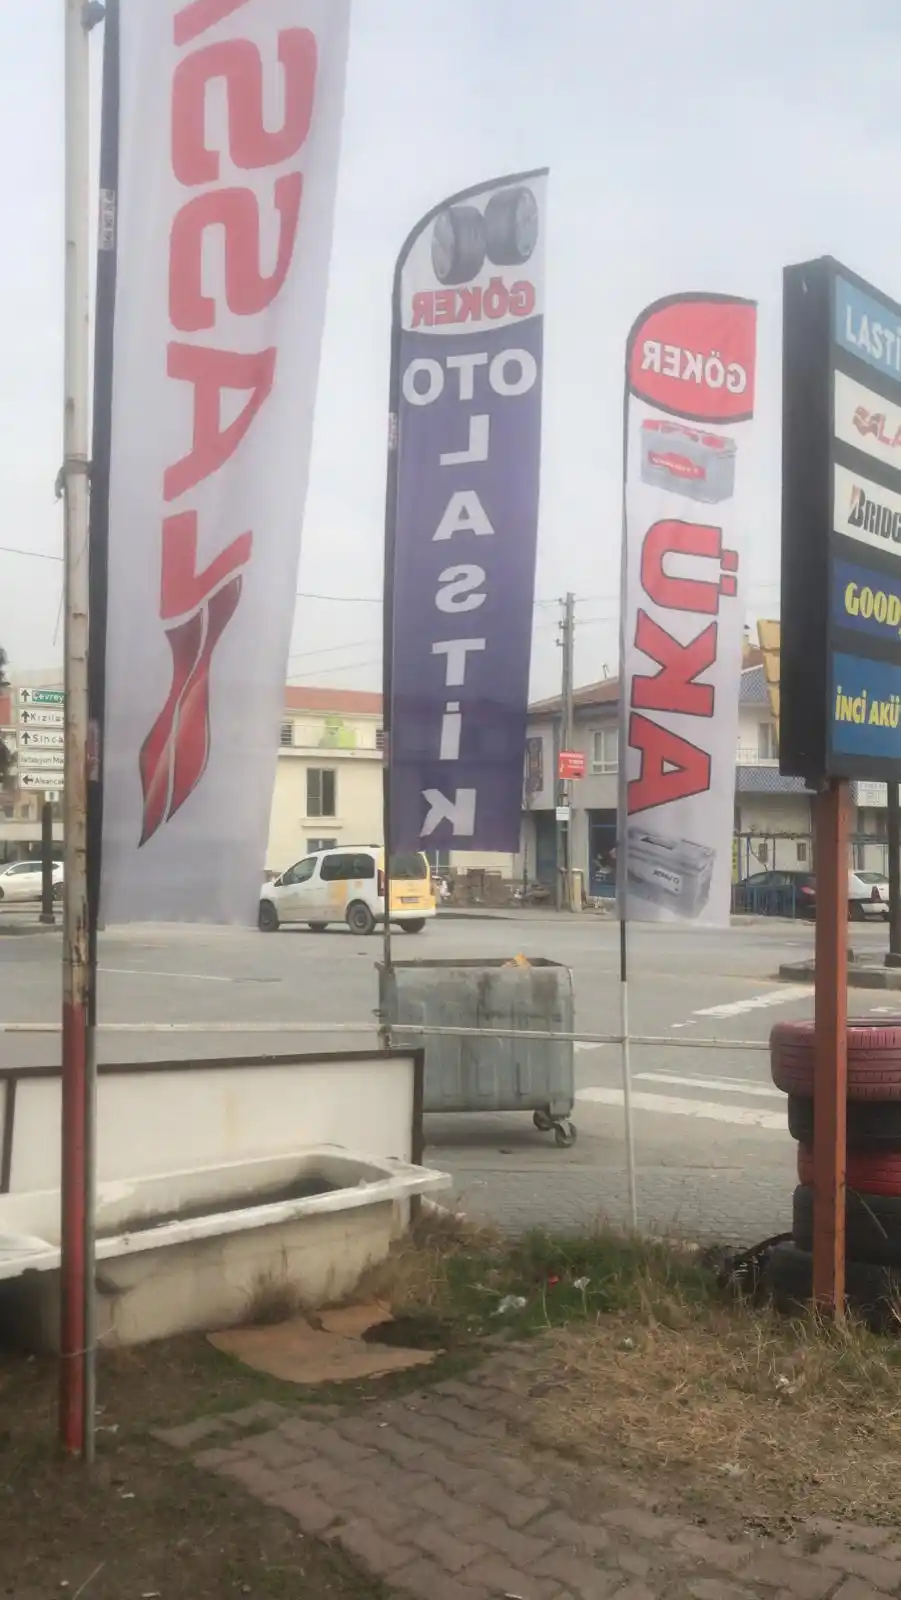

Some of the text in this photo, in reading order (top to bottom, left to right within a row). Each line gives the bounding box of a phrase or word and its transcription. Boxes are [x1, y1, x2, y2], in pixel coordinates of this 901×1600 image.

[844, 581, 901, 626] GOOD
[30, 712, 64, 722] Kızıla
[835, 685, 901, 728] İNCİ AKÜ
